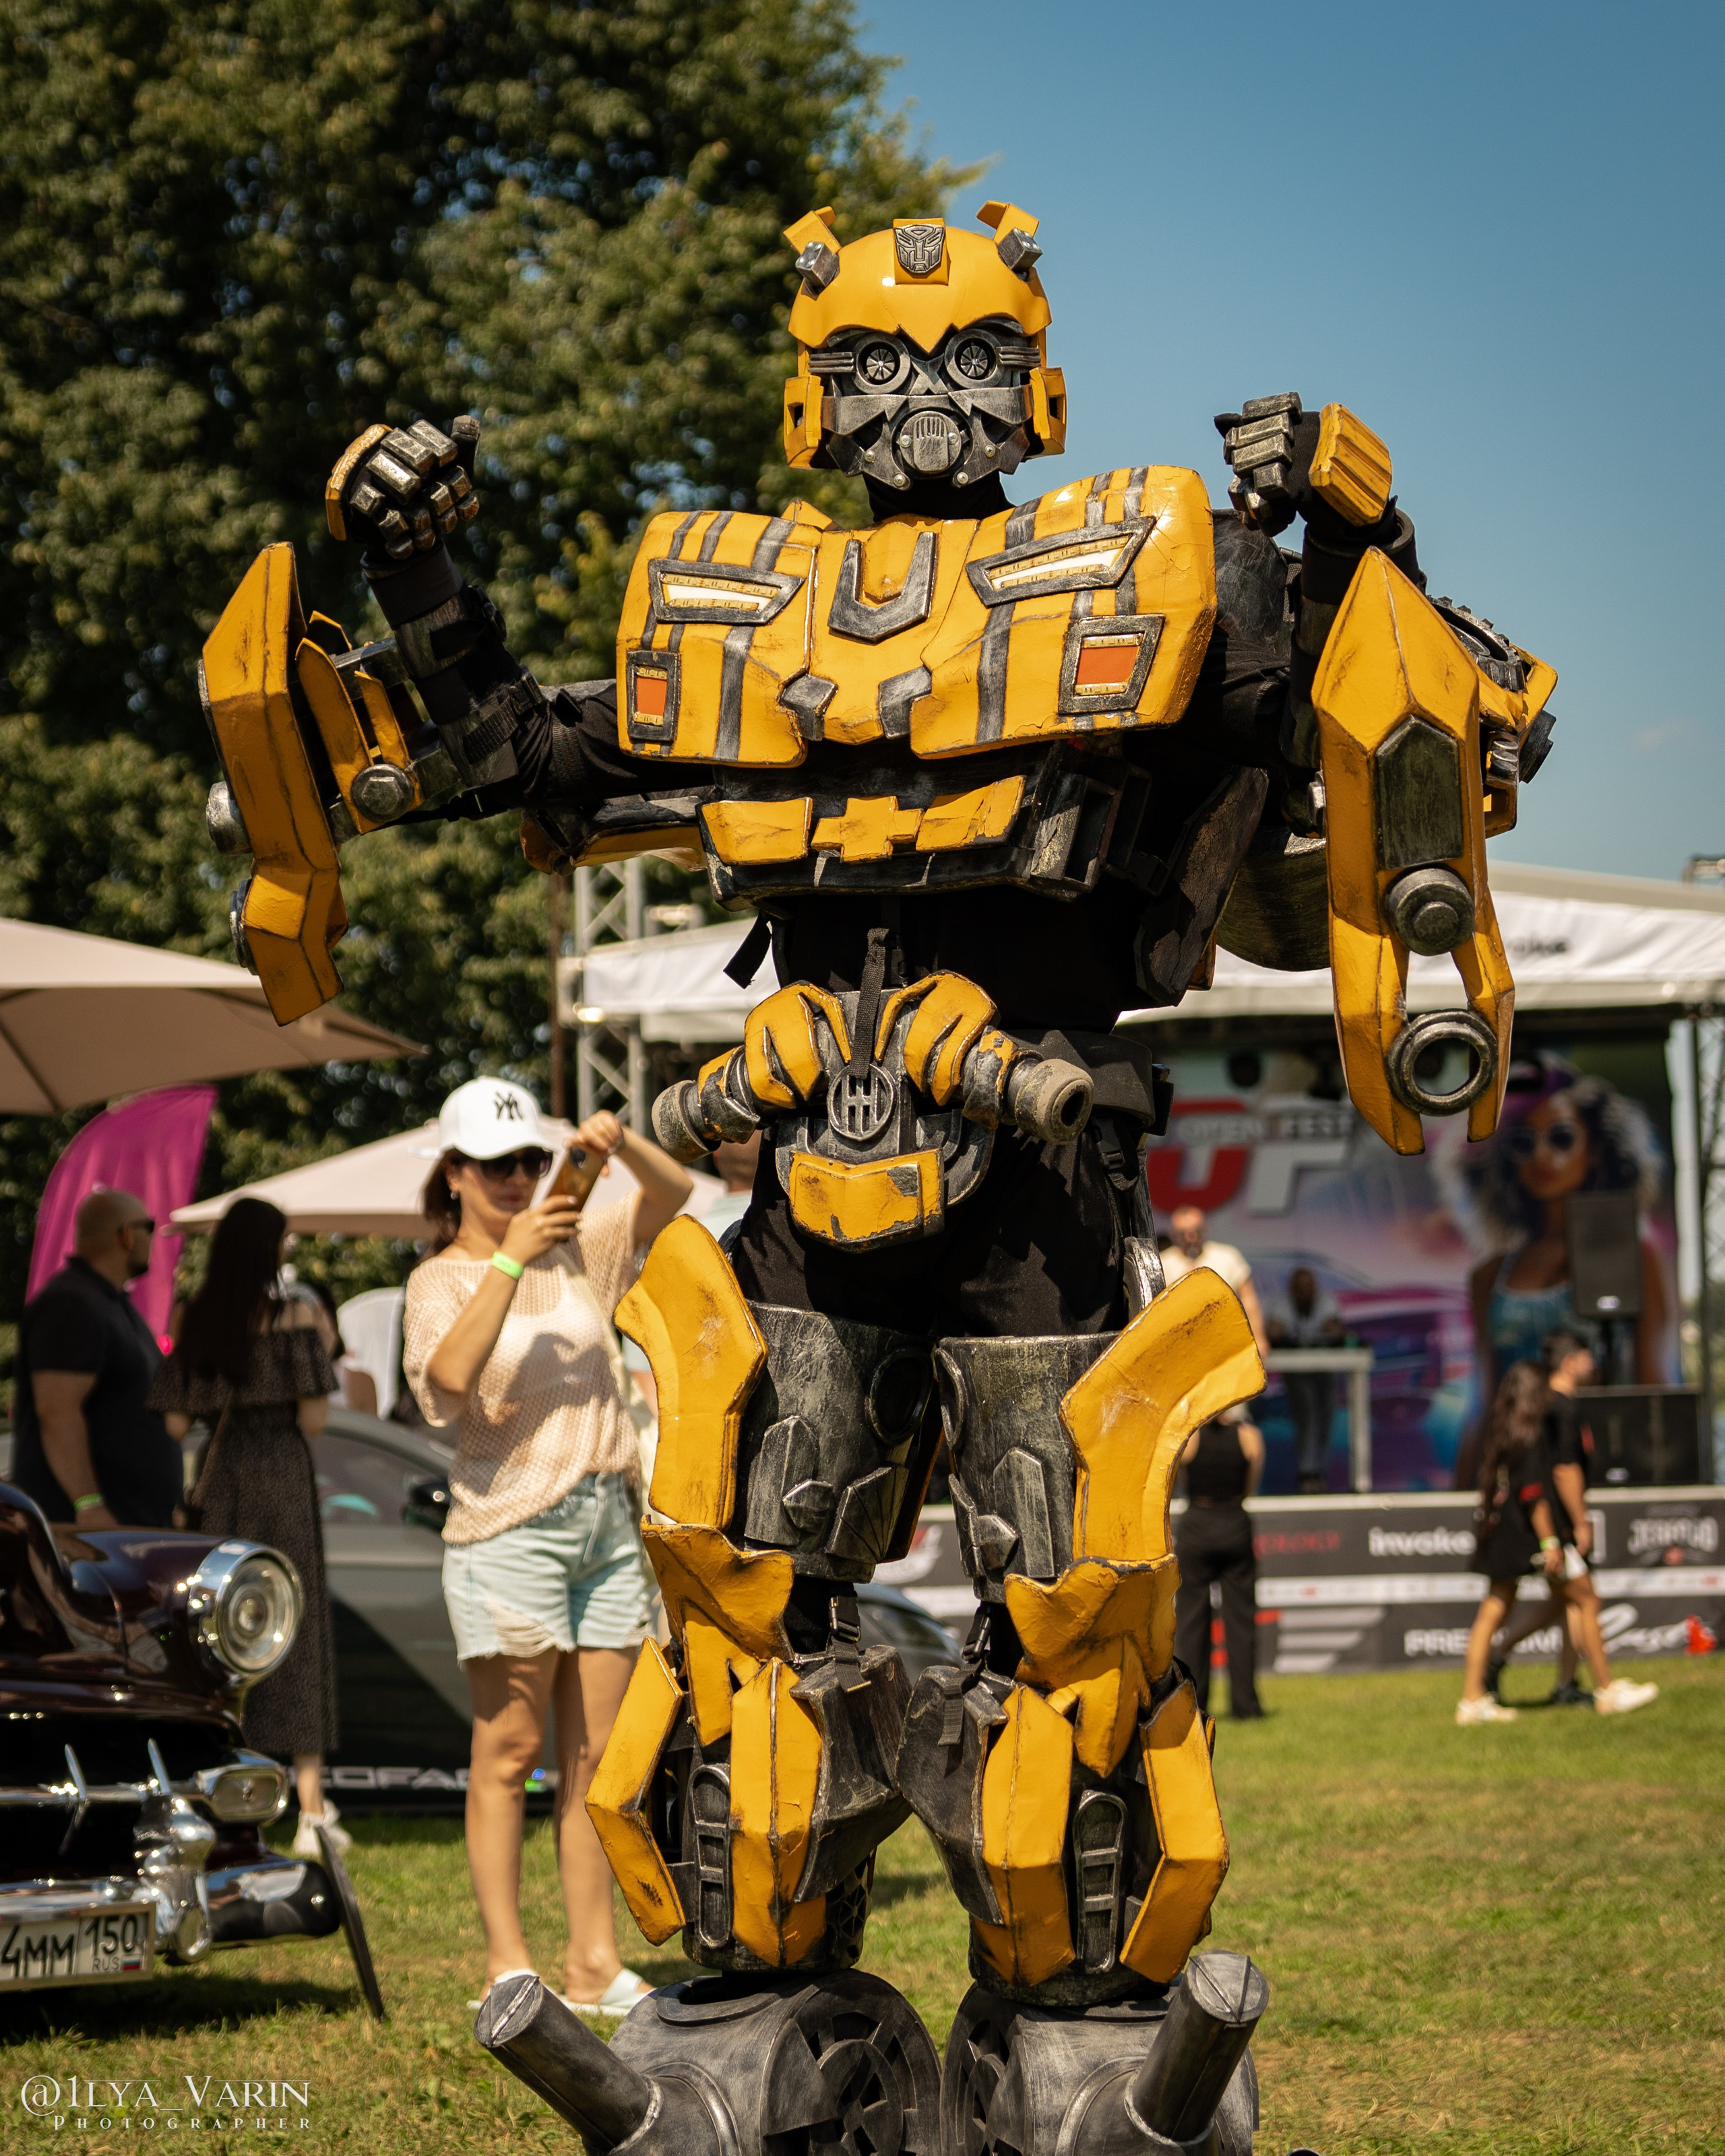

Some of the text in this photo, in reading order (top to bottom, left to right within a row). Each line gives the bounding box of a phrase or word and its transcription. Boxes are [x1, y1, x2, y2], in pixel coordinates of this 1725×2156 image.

[1369, 1526, 1478, 1556] invoke
[83, 1914, 137, 1955] 150
[92, 1956, 119, 1973] RUS
